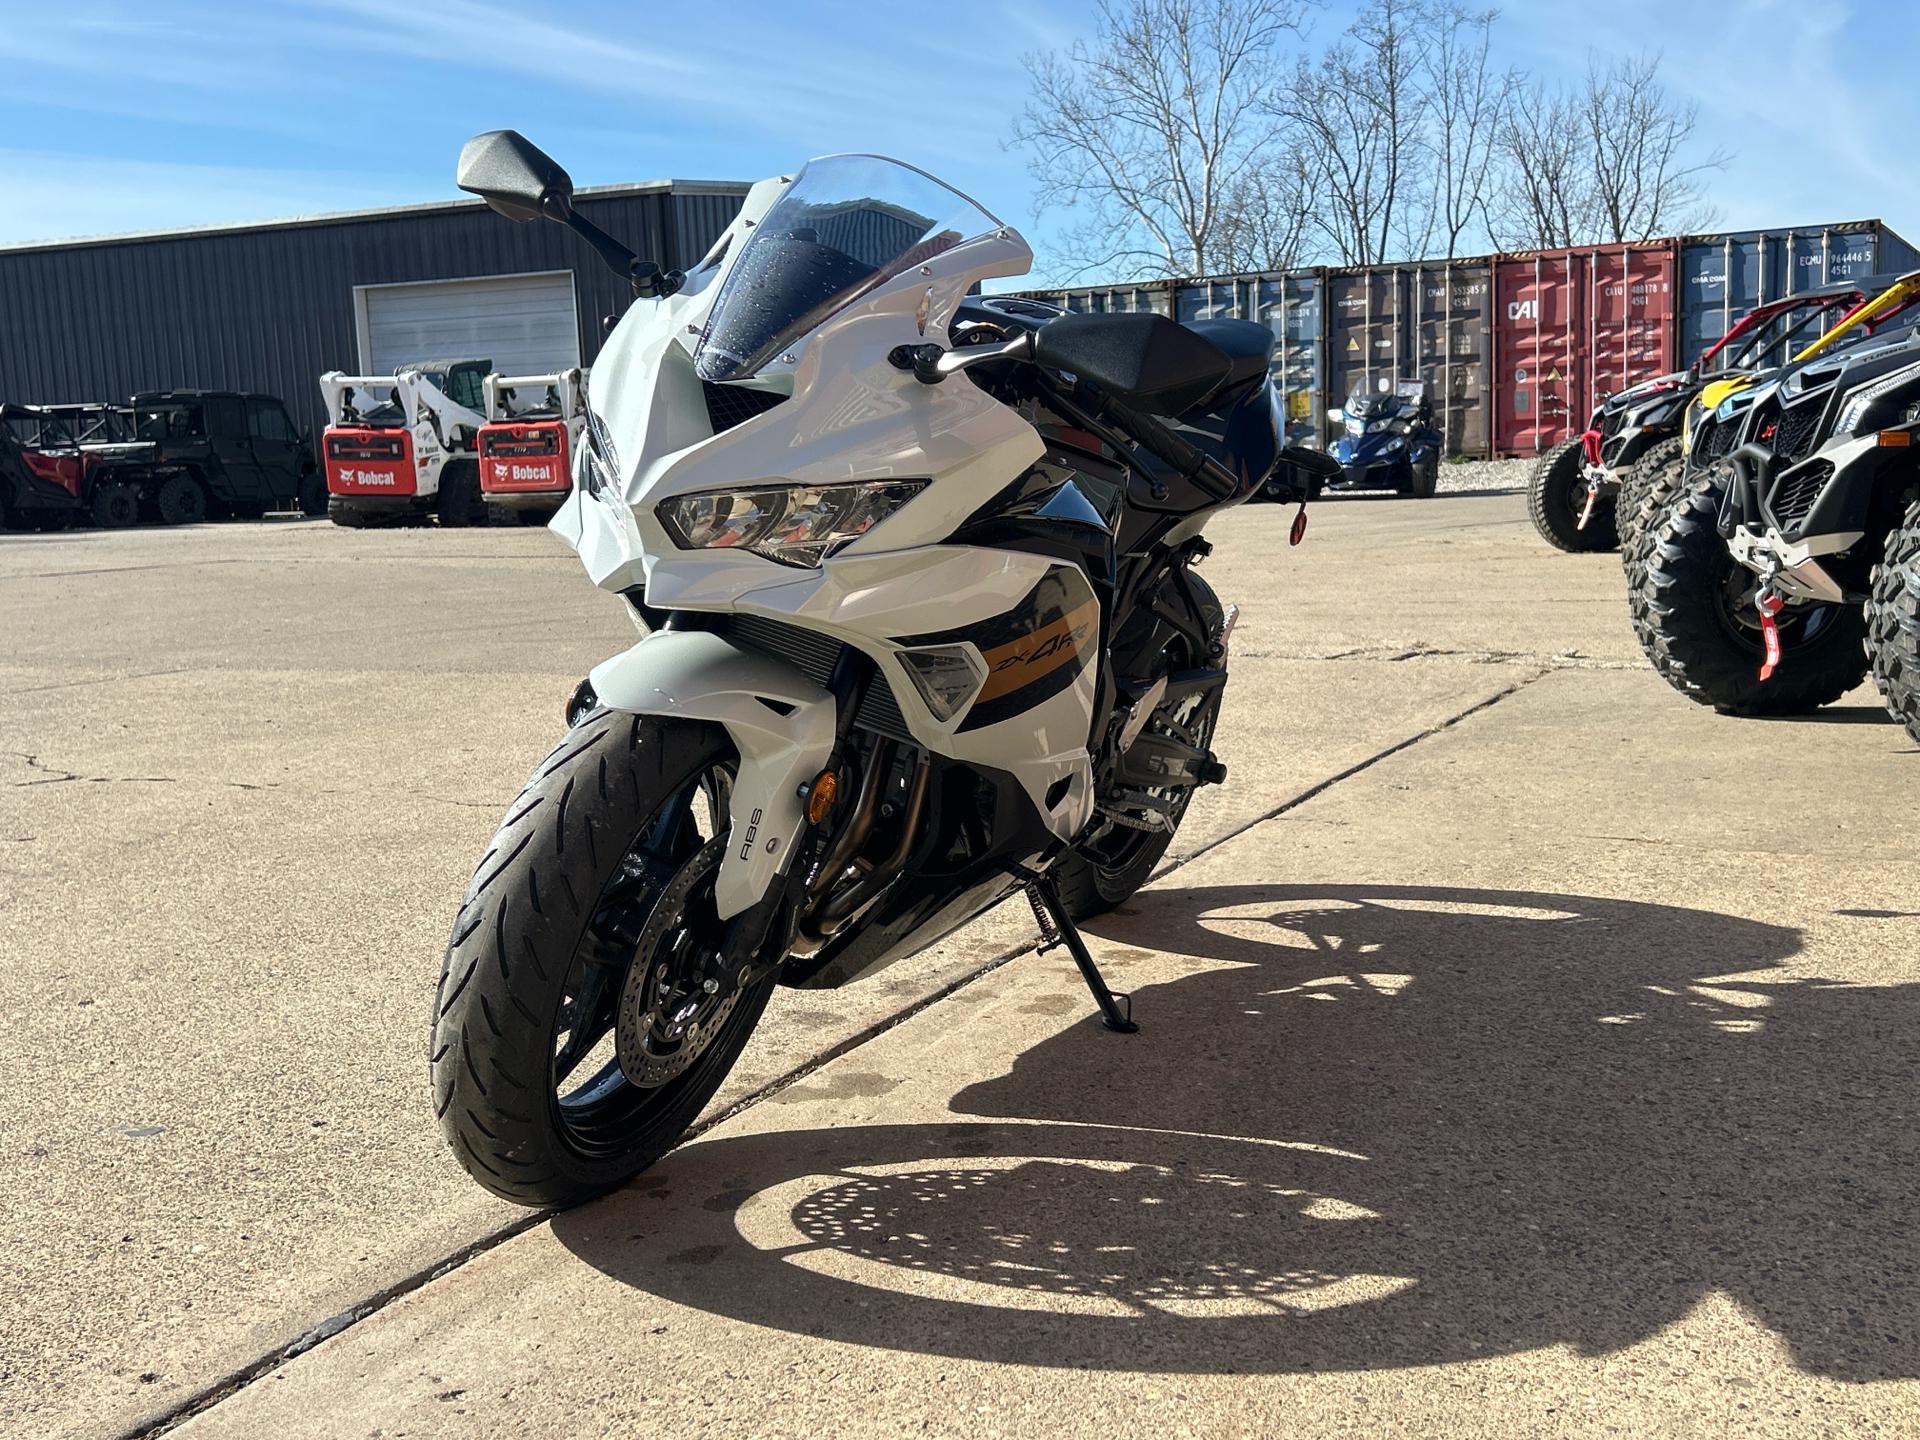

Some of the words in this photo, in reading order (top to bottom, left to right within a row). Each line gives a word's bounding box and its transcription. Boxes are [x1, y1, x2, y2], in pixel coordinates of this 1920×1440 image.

[1830, 251, 1862, 264] 964446
[1866, 250, 1872, 262] 5
[1830, 264, 1851, 276] 45G1
[1605, 286, 1623, 297] CAIU
[1662, 282, 1668, 293] 8
[357, 470, 395, 486] Bobcat
[512, 465, 551, 480] Bobcat
[740, 807, 762, 861] ABS
